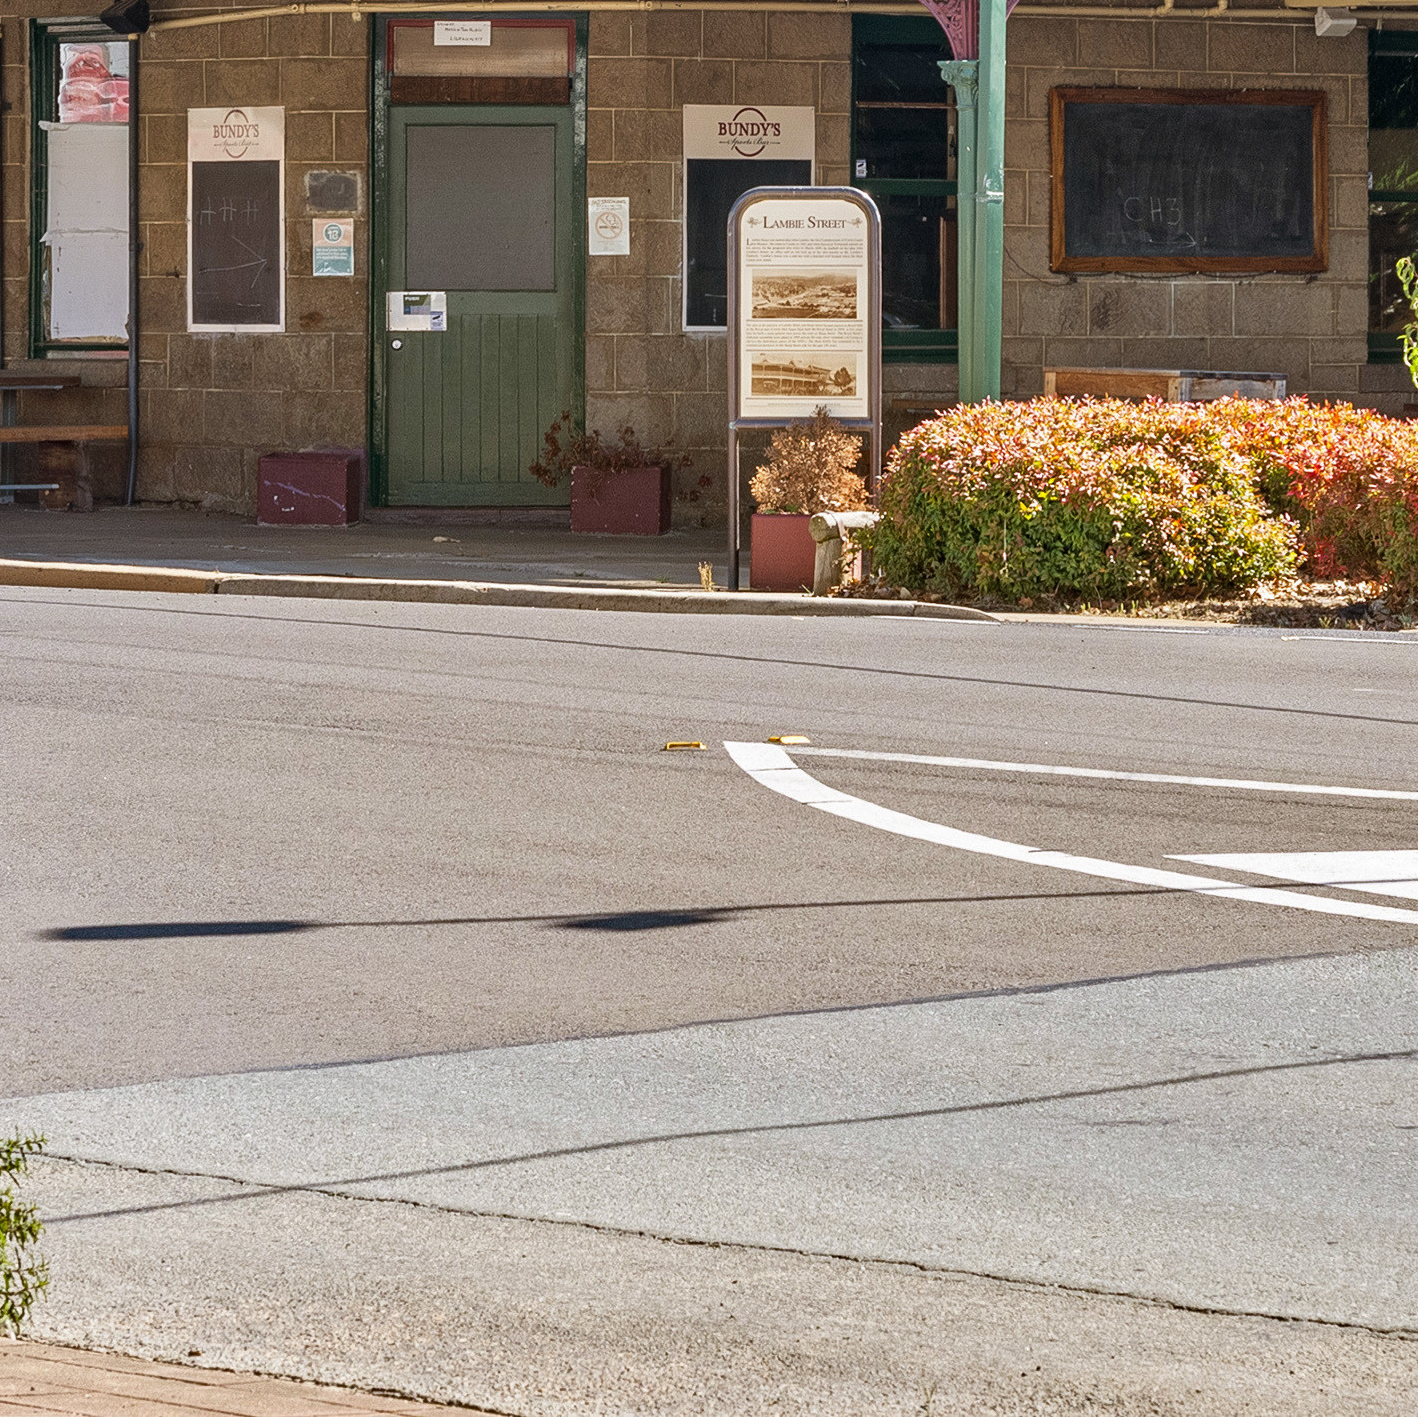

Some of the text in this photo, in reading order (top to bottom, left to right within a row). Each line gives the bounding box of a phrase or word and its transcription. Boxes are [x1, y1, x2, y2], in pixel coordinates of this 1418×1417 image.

[212, 123, 260, 139] BUNDY'S
[717, 122, 781, 137] BUNDY'S
[728, 137, 770, 151] Sports Bar
[763, 215, 846, 229] LAMBIE STREET
